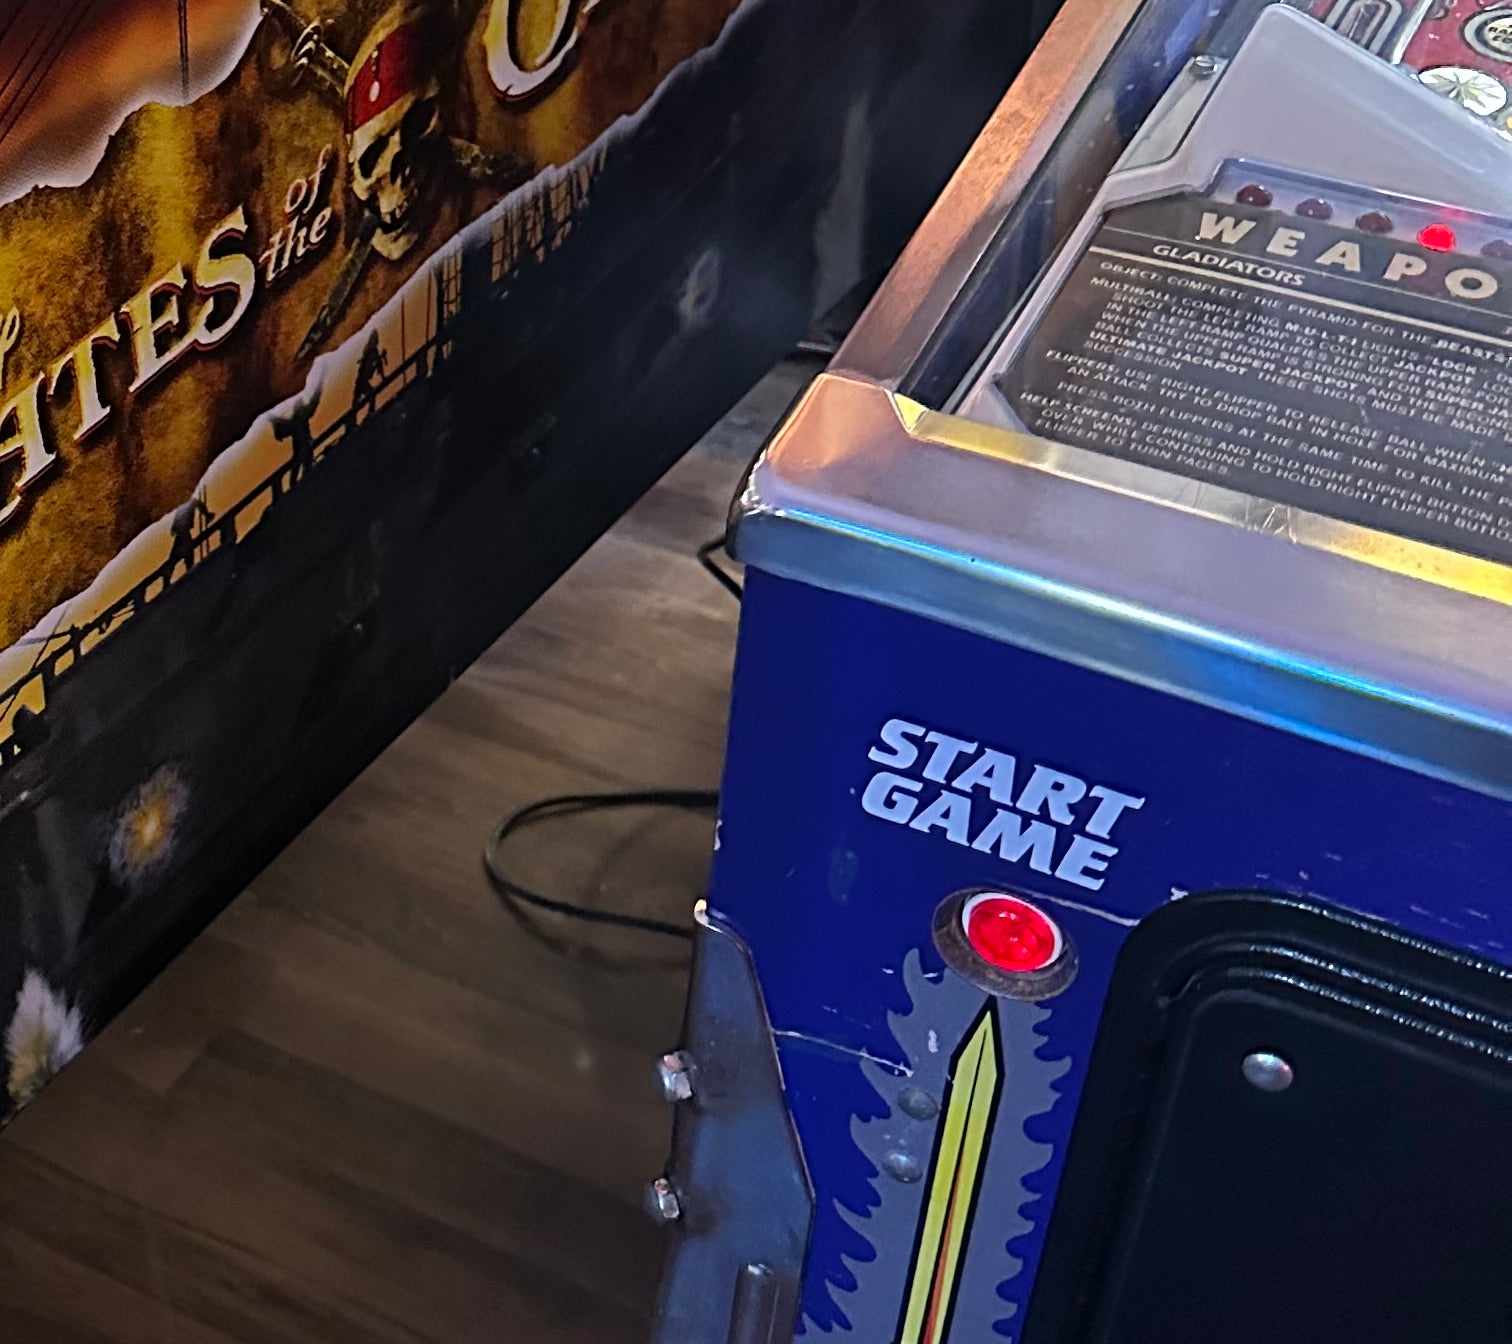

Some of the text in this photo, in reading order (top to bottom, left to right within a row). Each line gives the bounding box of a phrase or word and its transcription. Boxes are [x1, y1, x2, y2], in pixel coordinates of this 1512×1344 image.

[288, 144, 332, 215] of
[258, 205, 332, 282] the
[1152, 243, 1305, 287] GLADIATORS
[1105, 301, 1123, 312] IN
[1128, 306, 1154, 320] THE
[1159, 314, 1196, 330] LEFT
[1199, 323, 1246, 342] RAMP
[1247, 335, 1328, 362] QUALIFIES
[1333, 355, 1362, 370] THE
[1366, 363, 1420, 384] UPPER
[1423, 377, 1473, 397] RAMP
[1111, 291, 1163, 311] SHOOT
[1169, 305, 1195, 319] THE
[1203, 313, 1239, 329] LEFT
[1244, 323, 1289, 341] RAMP
[1295, 335, 1314, 347] TO
[1318, 339, 1389, 365] COLLECT
[1393, 357, 1473, 386] JACKPOT
[1166, 274, 1243, 300] COMPLETE
[1252, 294, 1283, 309] THE
[1288, 302, 1357, 327] PYRAMID
[1361, 320, 1394, 336] FOR
[1181, 297, 1281, 328] COMPLETING
[1089, 329, 1167, 356] ULTIMATE
[1257, 371, 1307, 391] THESE
[1370, 398, 1416, 418] MUST
[1100, 310, 1147, 329] WHEN
[1151, 322, 1180, 337] THE
[1183, 330, 1233, 350] UPPER
[1235, 343, 1282, 362] RAMP
[1283, 354, 1299, 366] IS
[1386, 380, 1421, 396] FOR
[1424, 389, 1484, 411] SUPER
[1219, 350, 1275, 371] SUPER
[1366, 386, 1402, 403] AND
[1407, 396, 1437, 412] THE
[1019, 391, 1493, 524] HELP DEPRESS AND HOLD RIGHT FLIPPER BUTTON
[1056, 380, 1493, 502] PRESS BOTH FLIPPERS AT THE SAME TIME TO KILL THE
[1066, 364, 1505, 485] AN TRY TO DROP BALL IN HOLE FOR MAXIMUM
[1103, 435, 1124, 447] TO
[1128, 441, 1172, 460] TURN
[1124, 368, 1486, 467] USE RIGHT FLIPPER TO RELEASE BALL WHEN
[1144, 434, 1246, 468] CONTINUING
[1251, 462, 1272, 475] TO
[1274, 468, 1322, 489] HOLD
[1324, 482, 1376, 504] RIGHT
[1380, 497, 1450, 525] FLIPPER
[1452, 517, 1512, 542] BUTTO
[868, 718, 1145, 839] START
[861, 771, 1119, 891] GAME
